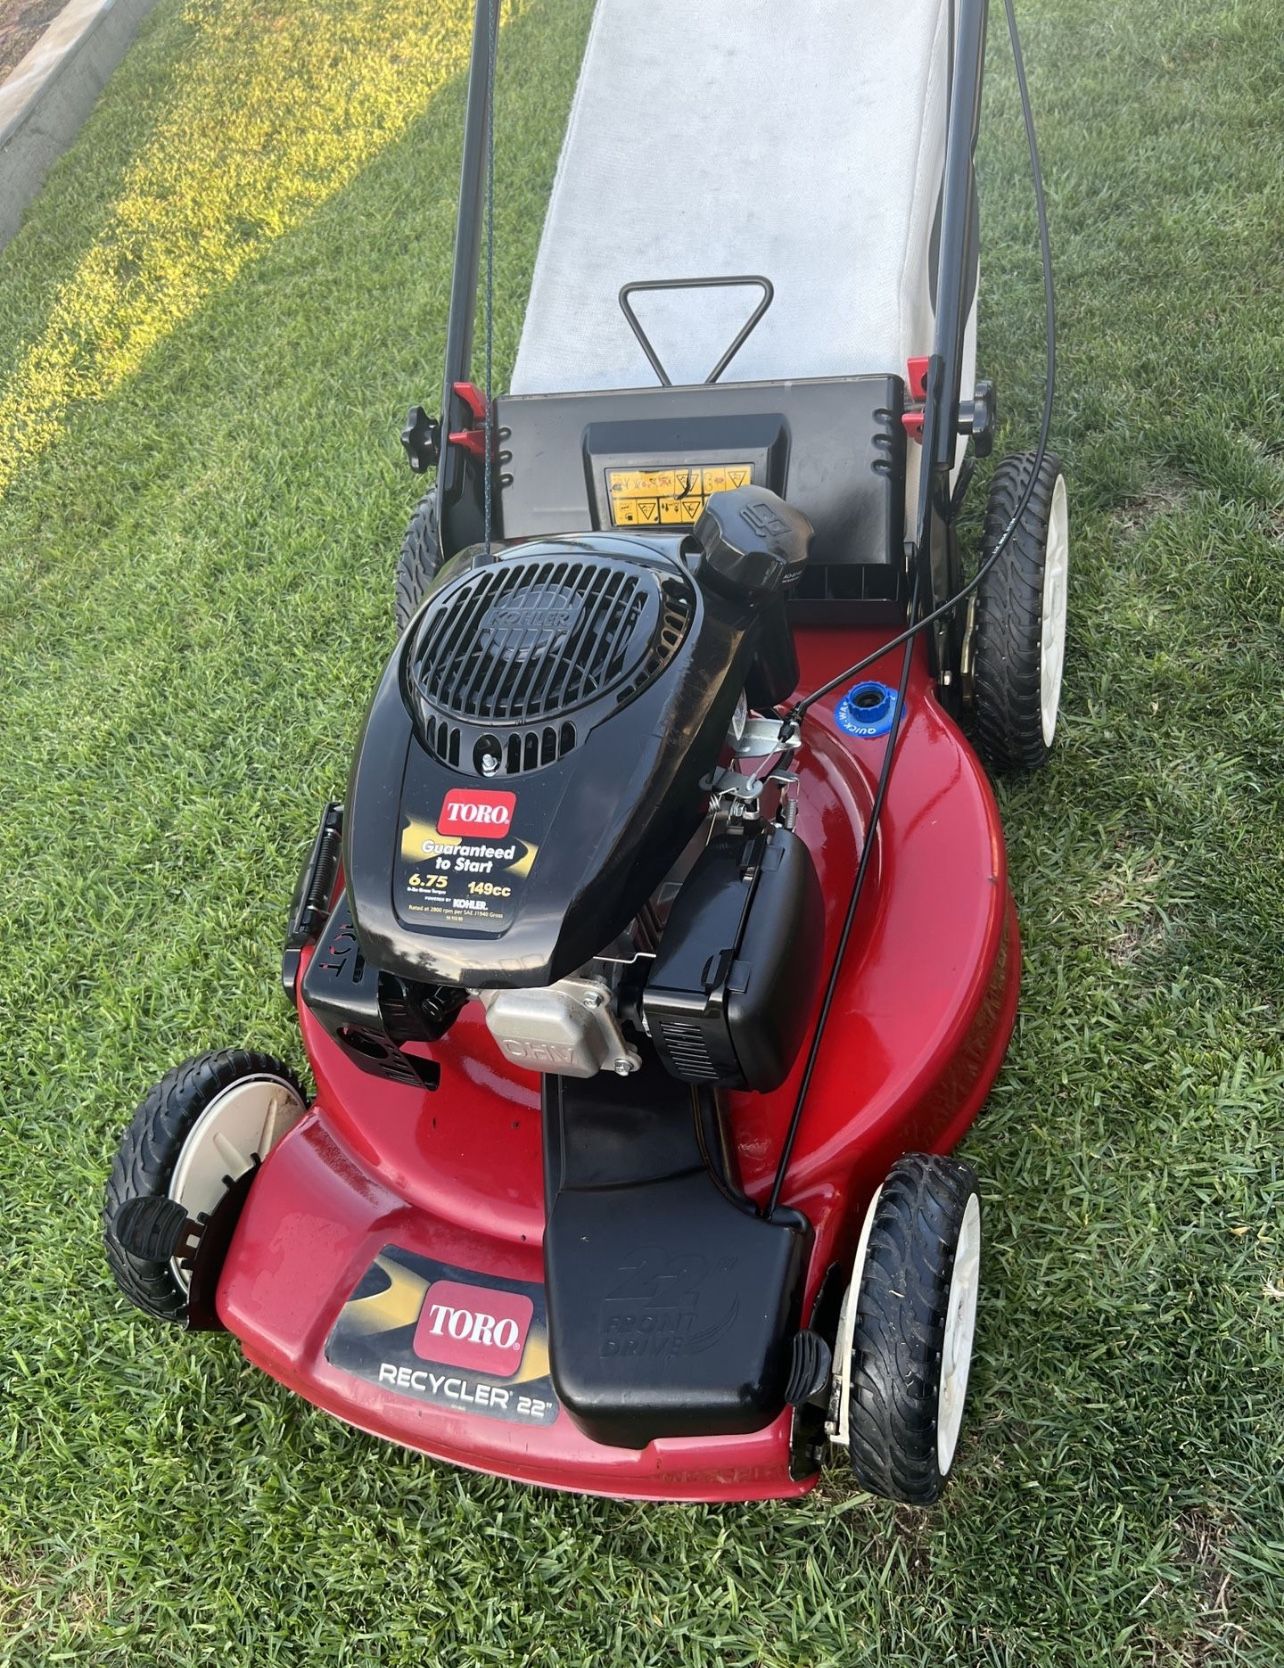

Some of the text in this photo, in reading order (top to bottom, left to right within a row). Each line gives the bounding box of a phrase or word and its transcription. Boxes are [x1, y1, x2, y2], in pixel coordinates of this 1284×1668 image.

[491, 610, 570, 627] KOHLER
[422, 840, 516, 860] Guaranteed
[435, 857, 493, 873] to Start
[408, 873, 511, 897] 6.75 149cc
